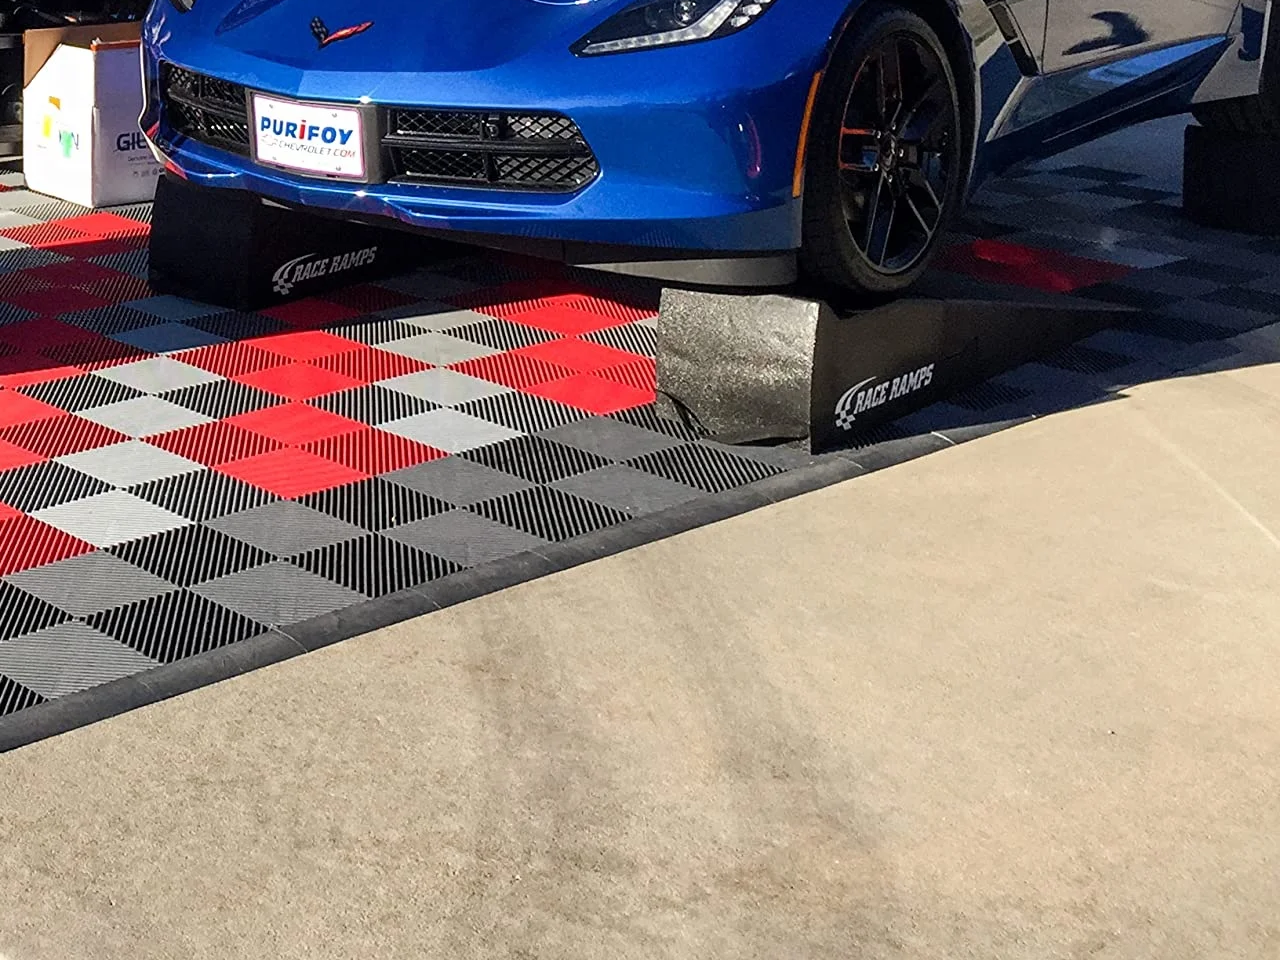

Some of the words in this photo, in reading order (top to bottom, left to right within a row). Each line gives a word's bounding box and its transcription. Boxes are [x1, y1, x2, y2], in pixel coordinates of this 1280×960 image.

[291, 258, 329, 283] RACE
[329, 246, 378, 274] RAMPS
[853, 381, 890, 415] RACE
[889, 363, 935, 401] RAMPS
